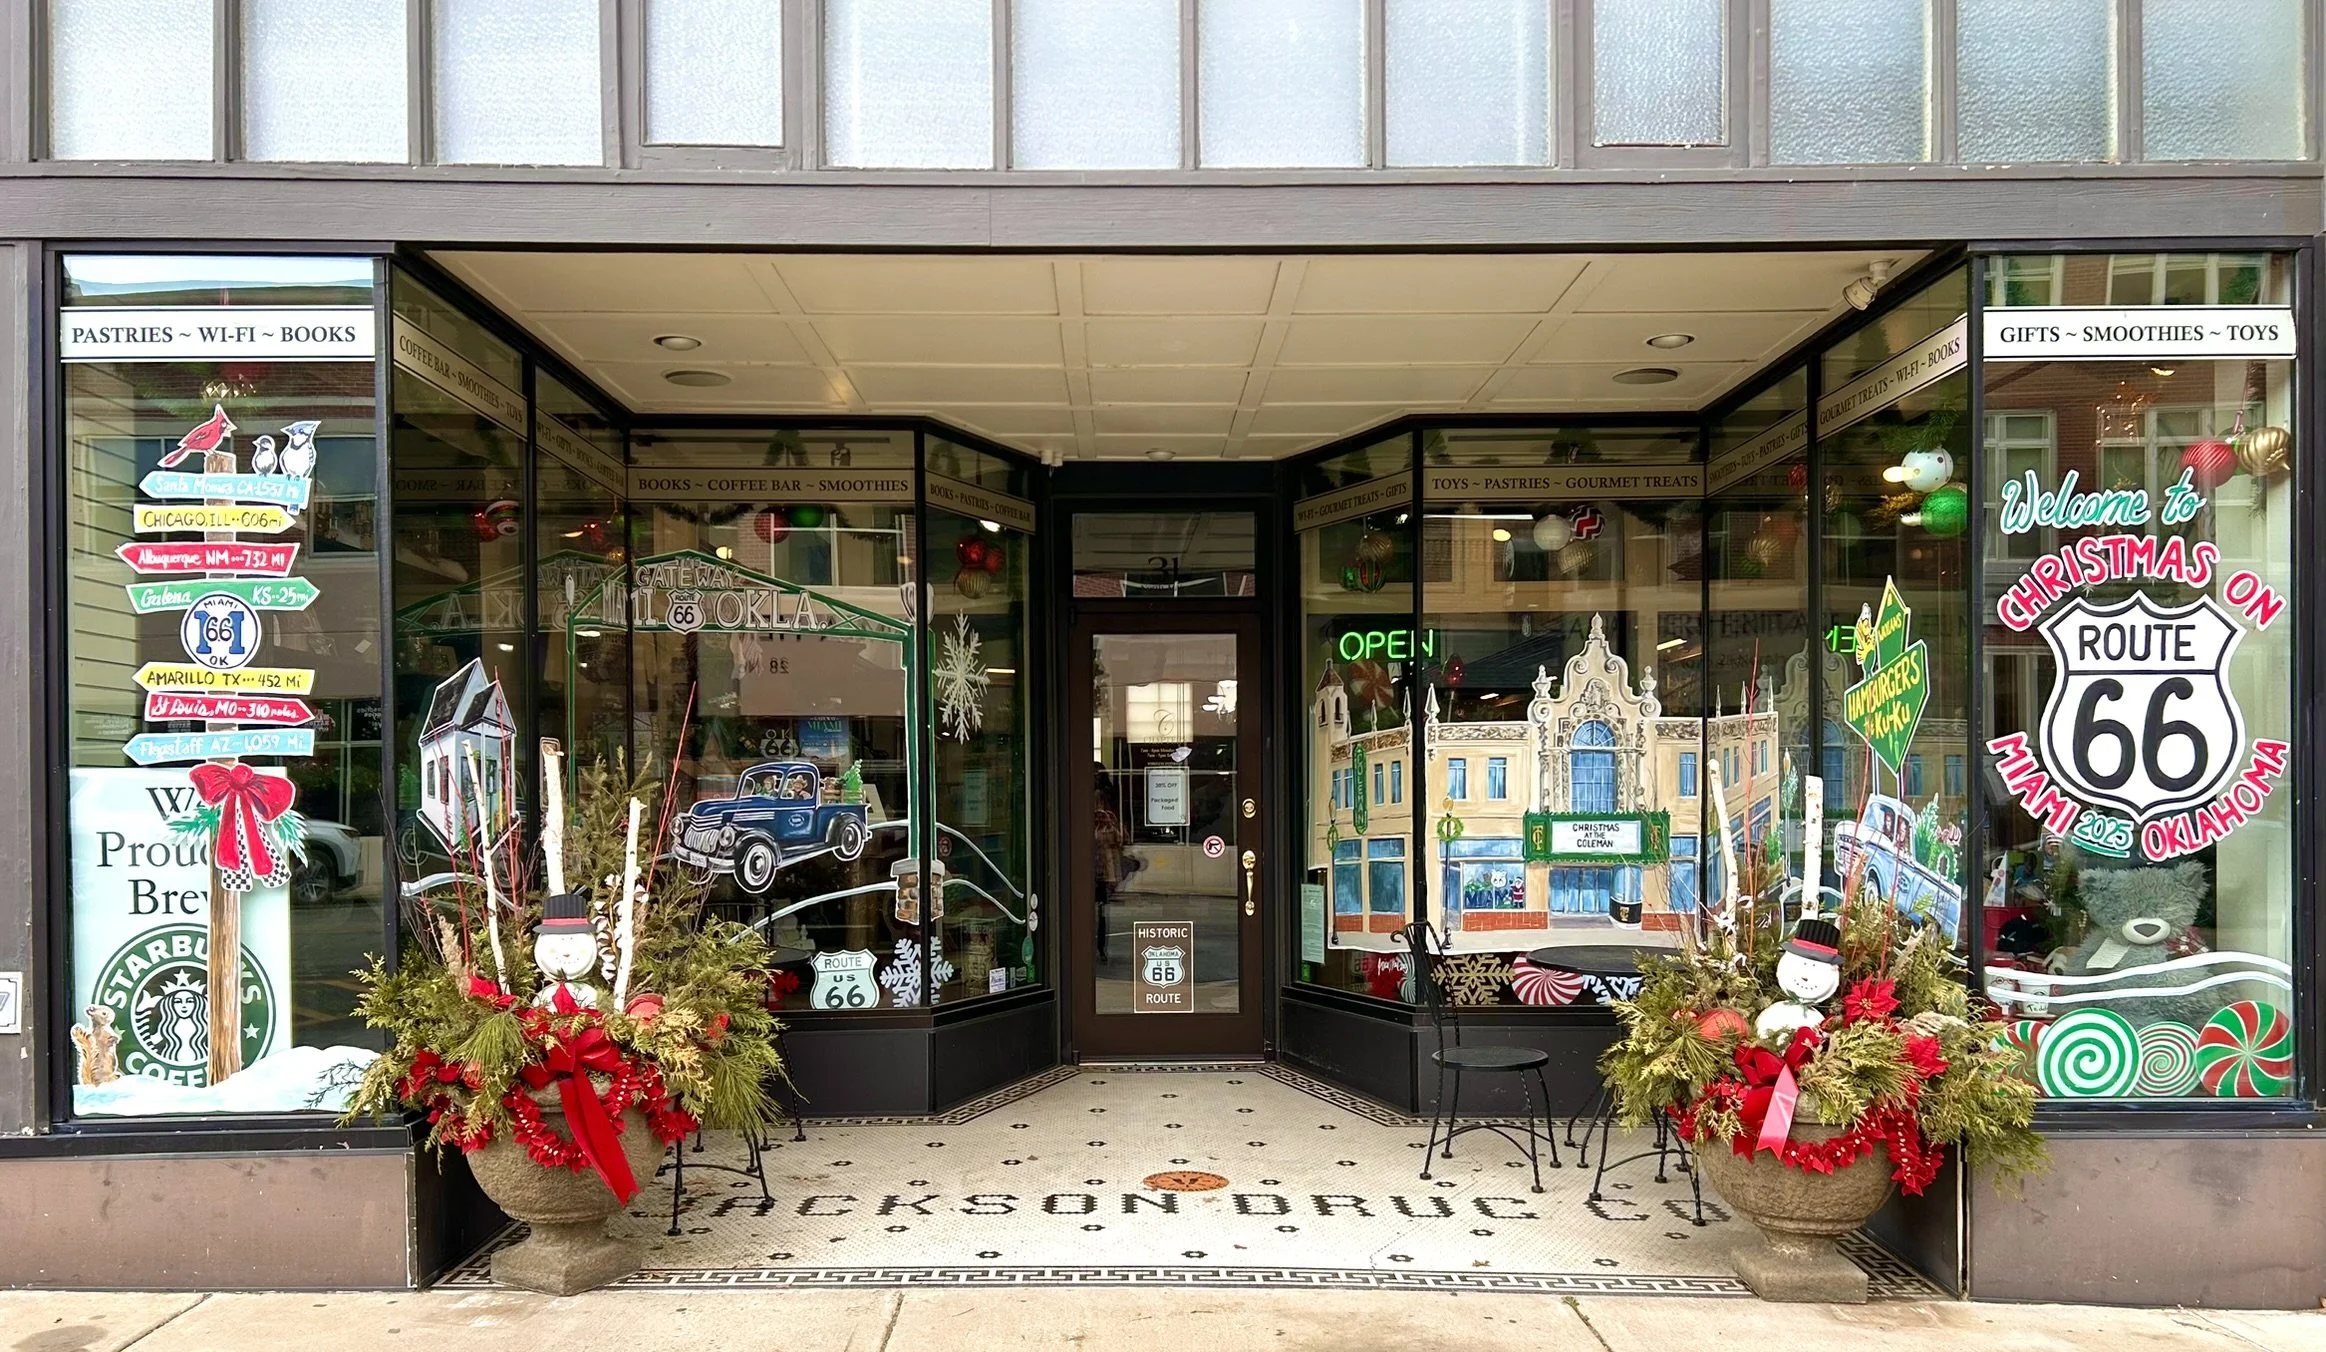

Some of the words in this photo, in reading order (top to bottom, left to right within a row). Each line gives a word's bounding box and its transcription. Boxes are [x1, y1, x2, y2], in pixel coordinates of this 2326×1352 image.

[71, 326, 173, 344] PASTRIES
[199, 326, 257, 344] WI-FI
[279, 326, 356, 343] BOOKS
[2000, 326, 2060, 343] GIFTS
[2083, 324, 2204, 342] SMOOTHIES
[2226, 324, 2279, 341] TOYS
[399, 334, 434, 372] COFFEE
[434, 358, 451, 379] BAR
[457, 371, 500, 410] SMOOTHIES
[505, 403, 523, 424] TOYS
[1819, 394, 1857, 426] GOURMET
[1857, 377, 1889, 407] TREATS
[1895, 362, 1920, 386] WI-FI
[1927, 336, 1960, 368] BOOKS
[1741, 449, 1755, 469] TOYS
[1759, 433, 1786, 458] PASTRIES
[155, 476, 190, 494] Santa
[638, 479, 691, 491] BOOKS
[707, 479, 768, 491] COFFEE
[771, 479, 801, 491] BAR
[818, 479, 909, 492] SMOOTHIES
[1432, 477, 1469, 490] TOYS
[1484, 476, 1550, 490] PASTRIES
[1566, 475, 1641, 489] GOURMET
[1643, 474, 1698, 488] TREATS
[930, 483, 954, 500] BOOKS
[959, 491, 990, 511] PASTRIES
[995, 503, 1018, 519] COFFEE
[1019, 509, 1031, 523] BAR
[1318, 495, 1351, 517] GOURMET
[1353, 490, 1379, 508] TREATS
[1385, 482, 1407, 498] GIFTS
[2000, 469, 2150, 535] Welcome
[2161, 466, 2207, 526] to
[137, 550, 202, 569] Albuquerque
[271, 553, 285, 566] MI
[635, 564, 739, 588] GATEWAY
[1997, 534, 2221, 632] CHRISTMAS
[2223, 570, 2287, 631] ON
[141, 585, 192, 608] Galena
[203, 599, 239, 609] MIAMI
[675, 594, 696, 602] ROUTE
[673, 605, 695, 625] 66
[715, 590, 828, 630] OKLA.
[205, 616, 232, 643] 66
[1338, 628, 1434, 661] OPEN
[2078, 623, 2195, 662] ROUTE
[209, 655, 229, 666] OK
[147, 670, 215, 686] AMARILLO
[258, 674, 281, 688] 452
[286, 674, 301, 688] Mi
[1847, 650, 1921, 723] HAMBURGERS
[151, 697, 170, 716] St
[2072, 676, 2209, 792] 66
[139, 738, 204, 760] Flagstaff
[1356, 753, 1364, 826] COLEMAN
[1986, 730, 2082, 838] MIAMI
[146, 787, 206, 822] W
[2141, 739, 2290, 862] OKLAHOMA
[1572, 823, 1620, 833] CHRISTMAS
[2073, 809, 2134, 849] 2025
[1576, 838, 1614, 848] COLEMAN
[128, 878, 208, 915] Bre
[1137, 927, 1188, 938] HISTORIC
[103, 934, 262, 1009] STARBUS
[824, 956, 863, 969] ROUTE
[1152, 967, 1175, 982] 66
[833, 973, 856, 982] US
[824, 983, 867, 1009] 66
[1145, 993, 1181, 1004] ROUTE
[1231, 1192, 1541, 1220] DRUG
